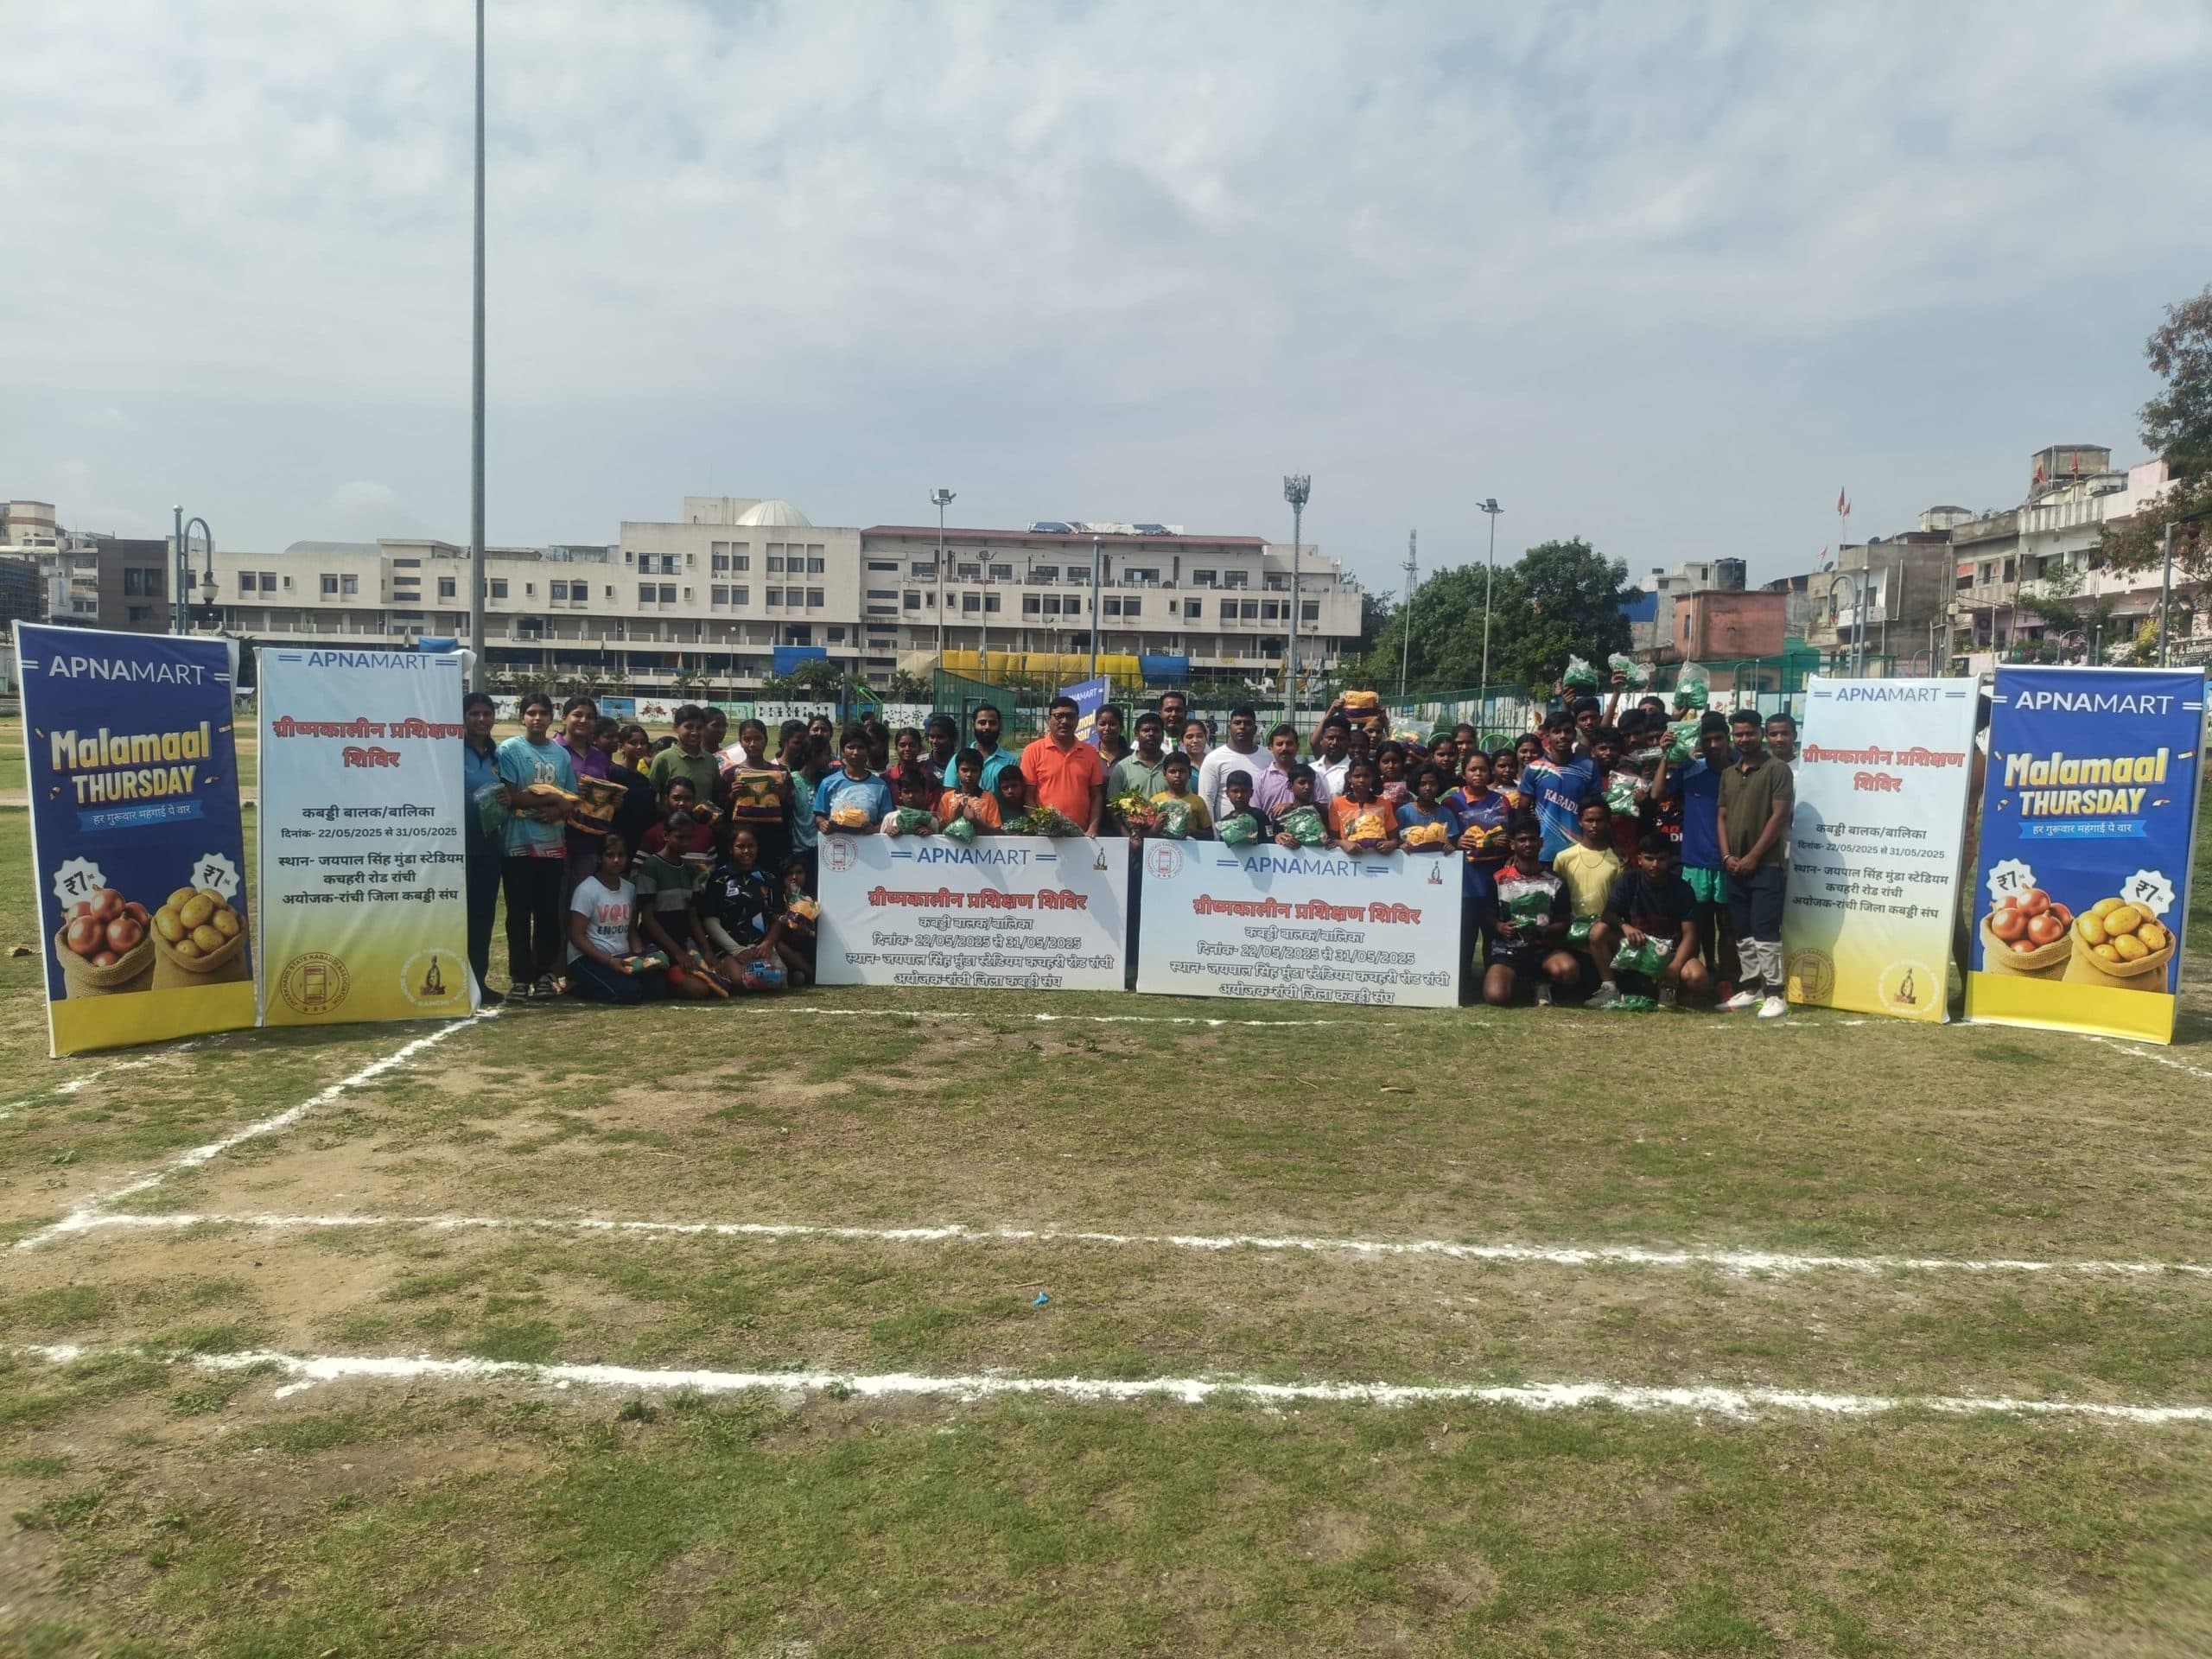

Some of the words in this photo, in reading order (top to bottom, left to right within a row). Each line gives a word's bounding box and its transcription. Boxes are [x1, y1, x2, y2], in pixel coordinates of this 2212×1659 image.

[48, 655, 206, 685] APNAMART
[308, 652, 430, 670] APNAMART
[1836, 688, 1941, 702] APNAMART
[2015, 690, 2174, 715] APNAMART
[272, 715, 386, 739] ग्रीष्मकालीन
[389, 717, 466, 740] प्रशिक्षण
[50, 721, 212, 771] Malamaal
[342, 747, 401, 768] शिविर
[1896, 746, 1965, 767] प्रशिक्षण
[533, 761, 556, 784] 18
[2004, 747, 2170, 788] Malamaal
[72, 766, 197, 804] THURSDAY
[1853, 772, 1902, 792] शिविर
[2019, 788, 2146, 817] THURSDAY
[92, 814, 105, 826] हर
[177, 804, 191, 815] वार
[302, 804, 340, 821] कबड्डी
[343, 804, 435, 819] बालक/बालिका
[281, 828, 315, 838] दिनांक-
[318, 829, 382, 838] 22/05/2025
[385, 826, 393, 837] से
[396, 827, 457, 837] 31/05/2025
[1816, 823, 1846, 836] कबड्डी
[1848, 825, 1927, 840] बालक/बालिका
[2033, 824, 2044, 835] हर
[2107, 822, 2115, 832] पे
[2118, 823, 2132, 833] वार
[278, 855, 315, 867] स्थान-
[319, 855, 364, 866] जयपाल
[367, 852, 391, 866] सिंह
[394, 853, 416, 868] मुंडा
[420, 851, 464, 864] स्टेडियम
[917, 847, 1031, 865] APNAMART
[1827, 843, 1878, 854] 22/05/2025
[1880, 845, 1887, 855] से
[1890, 848, 1944, 859] 31/05/2025
[1243, 856, 1362, 877] APNAMART
[1824, 866, 1860, 878] जयपाल
[1863, 867, 1883, 880] सिंह
[1885, 870, 1905, 883] मुंडा
[1908, 870, 1948, 885] स्टेडियम
[323, 871, 365, 885] कचहरी
[368, 871, 388, 884] रोड
[391, 870, 416, 882] रांची
[368, 889, 398, 902] जिला
[402, 887, 435, 903] कबड्डी
[438, 890, 458, 900] संघ
[868, 886, 964, 908] ग्रीष्मकालीन
[967, 888, 1035, 910] प्रशिक्षण
[1038, 889, 1088, 911] शिविर
[1826, 882, 1859, 895] कचहरी
[1862, 884, 1878, 896] रोड
[1881, 887, 1903, 898] रांची
[1192, 893, 1293, 919] ग्रीष्मकालीन
[1295, 899, 1365, 923] प्रशिक्षण
[1370, 902, 1422, 925] शिविर
[1859, 900, 1885, 913] जिला
[1888, 904, 1918, 918] कबड्डी
[1921, 907, 1939, 918] संघ
[918, 914, 951, 931] कबड्डी
[953, 915, 1034, 931] बालक/बालिका
[914, 934, 990, 948] 22/05/2025
[992, 934, 1004, 948] से
[1006, 937, 1082, 950] 31/05/2025
[1244, 925, 1279, 942] कबड्डी
[1280, 927, 1364, 944] बालक/बालिका
[882, 953, 927, 966] जयपाल
[928, 950, 951, 967] सिंह
[953, 952, 976, 969] मुंडा
[977, 952, 1023, 968] स्टेडियम
[1025, 954, 1065, 970] कचहरी
[1067, 955, 1087, 969] रोड
[1089, 954, 1114, 969] रांची
[1241, 944, 1319, 960] 22/05/2025
[1320, 946, 1333, 961] से
[1335, 950, 1415, 964] 31/05/2025
[973, 970, 1004, 987] जिला
[1207, 963, 1252, 977] जयपाल
[1254, 962, 1279, 979] सिंह
[1280, 964, 1304, 982] मुंडा
[1355, 969, 1397, 986] कचहरी
[1400, 971, 1421, 985] रोड
[1422, 971, 1450, 987] रांची
[1300, 984, 1333, 1001] जिला
